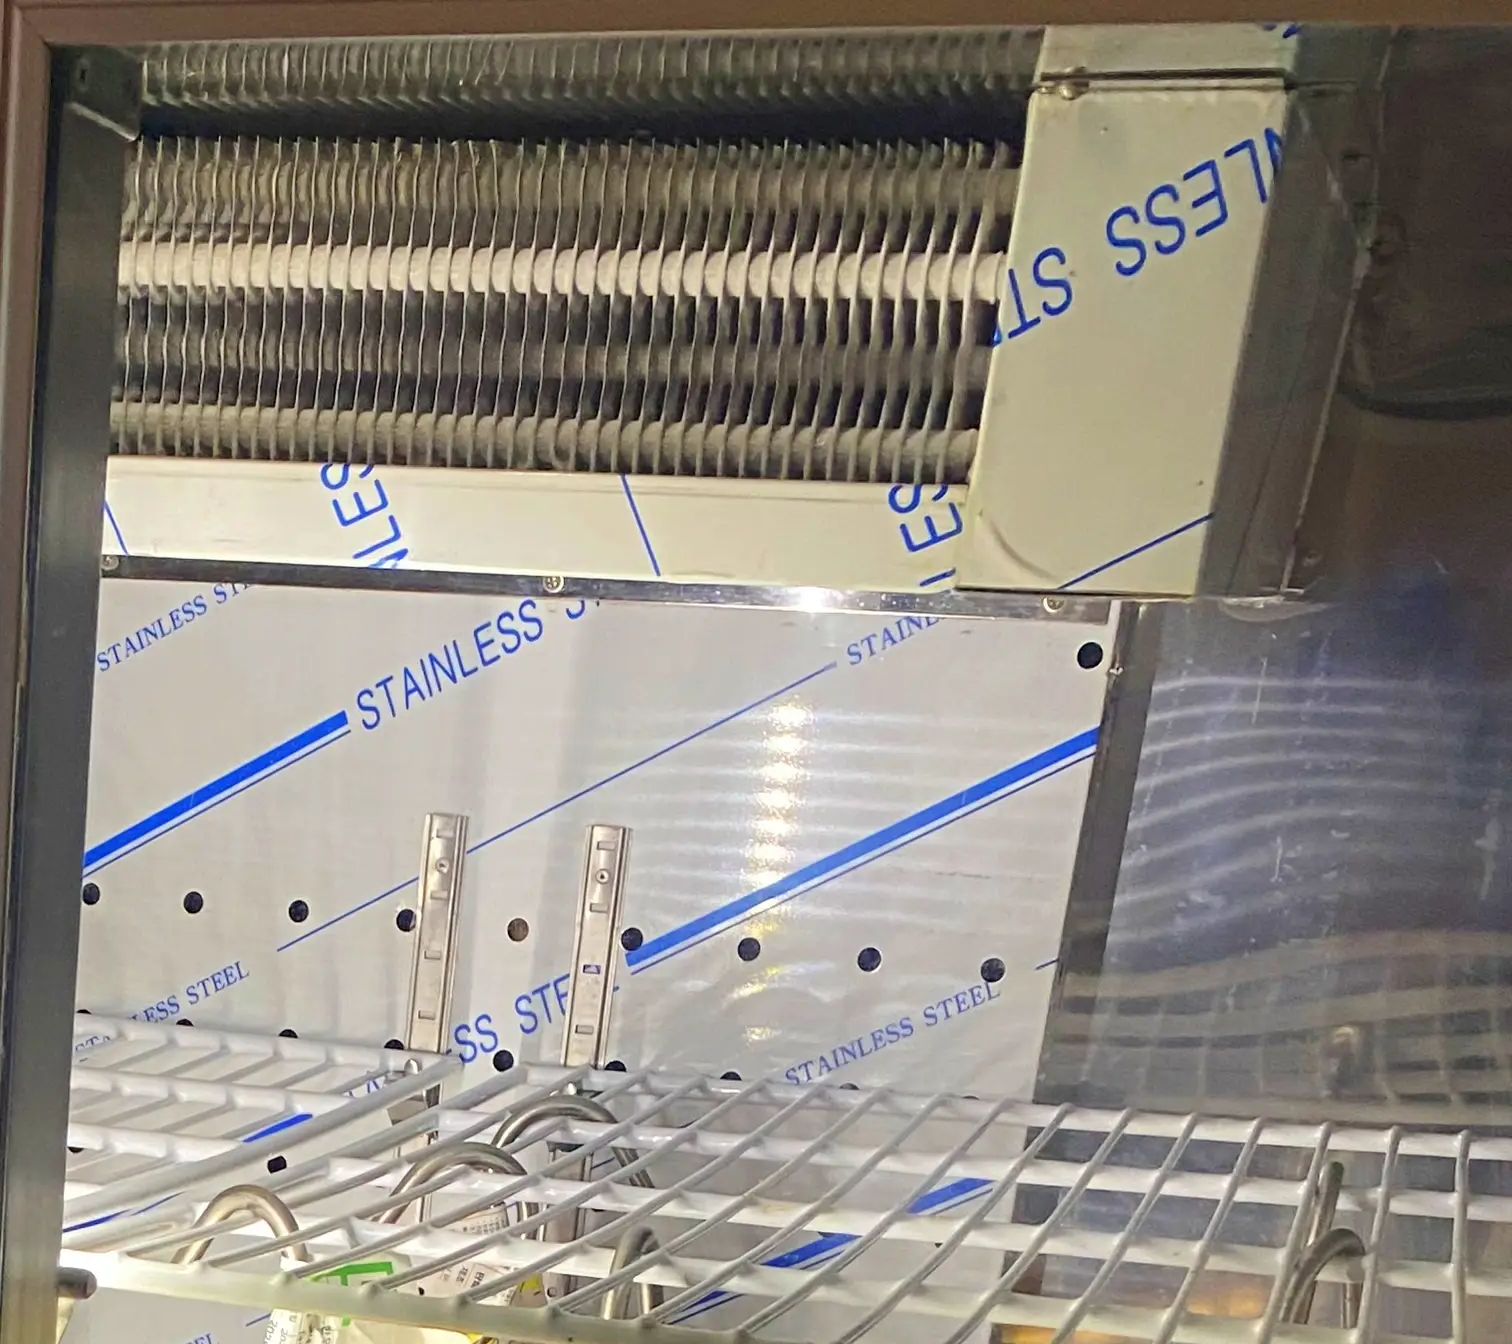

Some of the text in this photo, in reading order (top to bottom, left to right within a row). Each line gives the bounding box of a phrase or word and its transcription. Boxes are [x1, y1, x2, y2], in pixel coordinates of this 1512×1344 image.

[97, 595, 207, 671] STAINLESS
[356, 598, 544, 731] STAINLESS
[186, 961, 250, 1006] STEEL
[785, 981, 1001, 1086] STAINLESS STEEL
